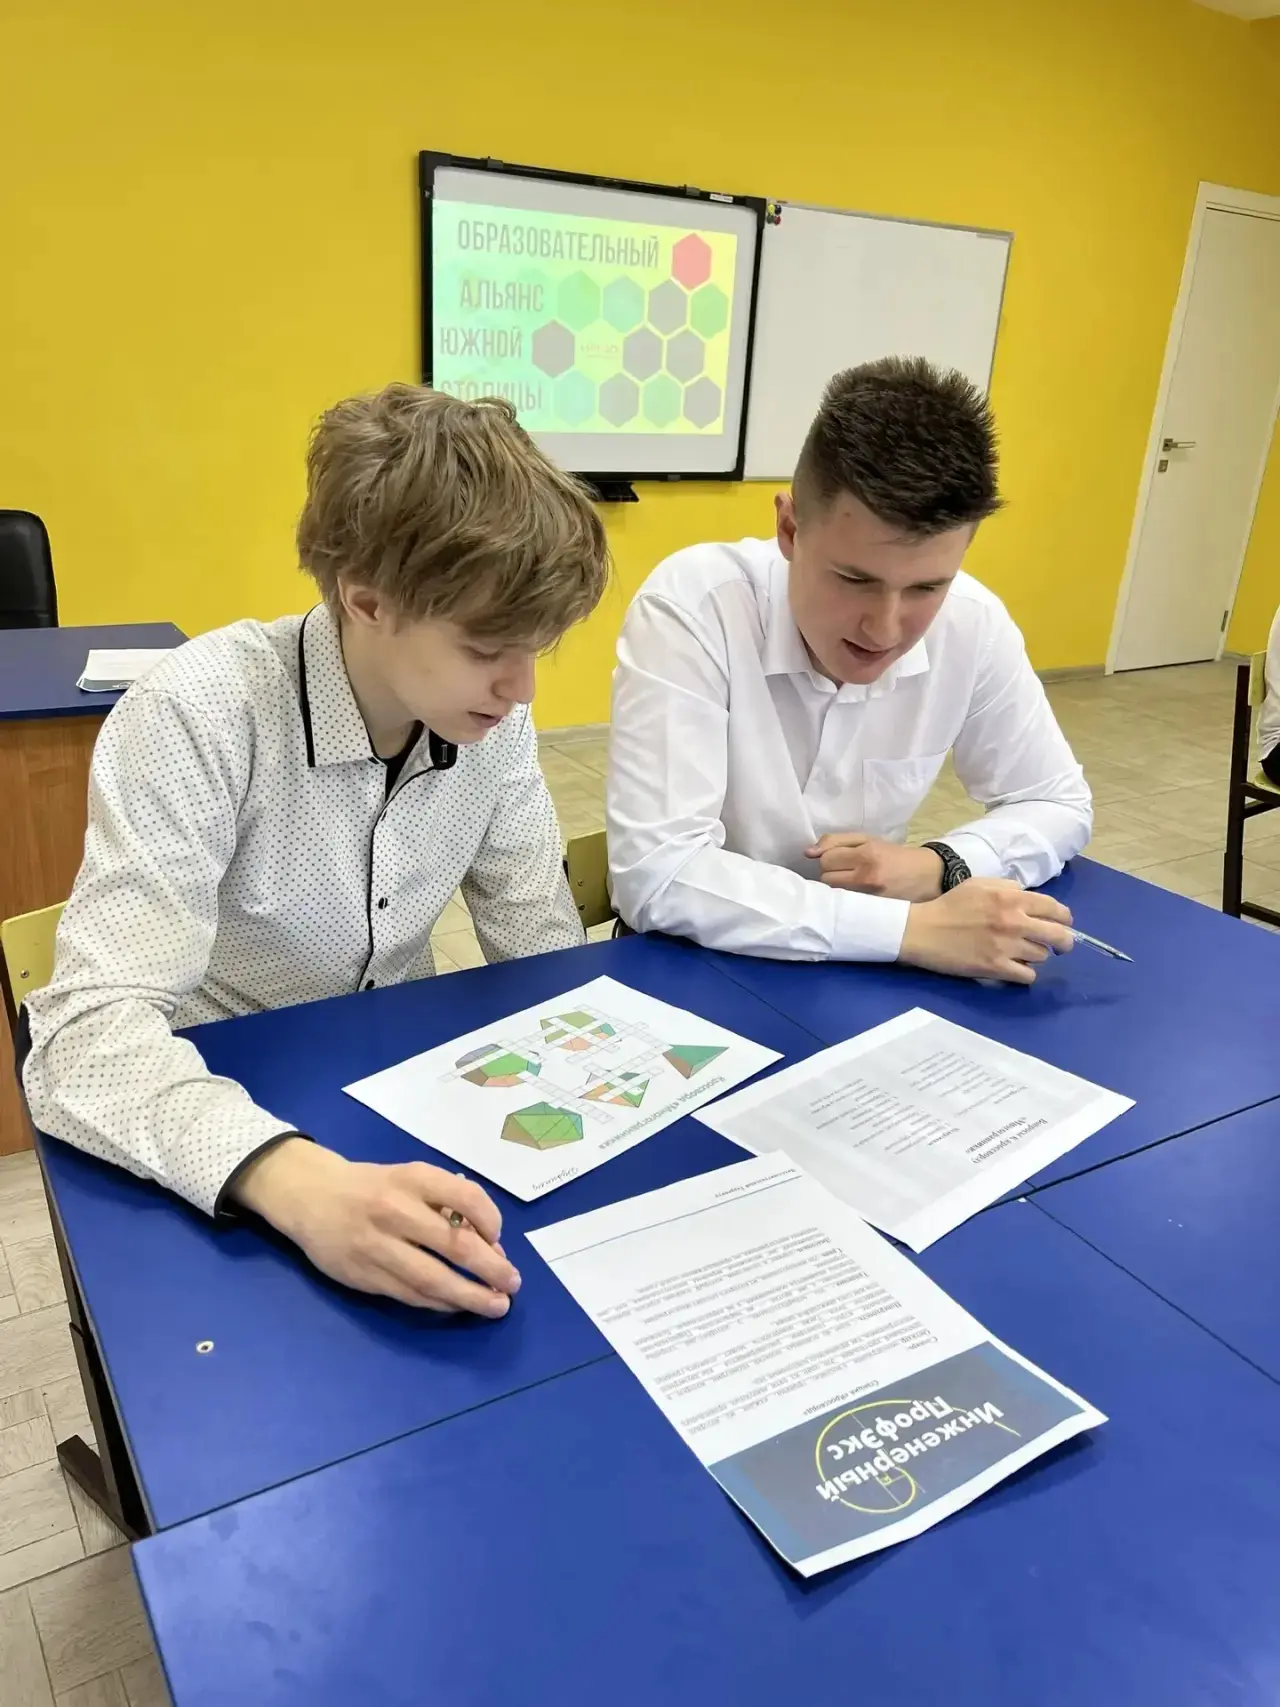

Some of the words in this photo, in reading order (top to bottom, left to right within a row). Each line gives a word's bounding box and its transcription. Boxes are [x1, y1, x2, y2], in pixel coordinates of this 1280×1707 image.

[458, 220, 659, 268] ОБРАЗОВАТЕЛЬНЫЙ
[460, 279, 544, 312] АЛЬЯНС
[440, 326, 522, 358] ЮЖНОЙ
[815, 1402, 1004, 1502] Инженерный
[826, 1396, 954, 1460] ПрофЭкс
